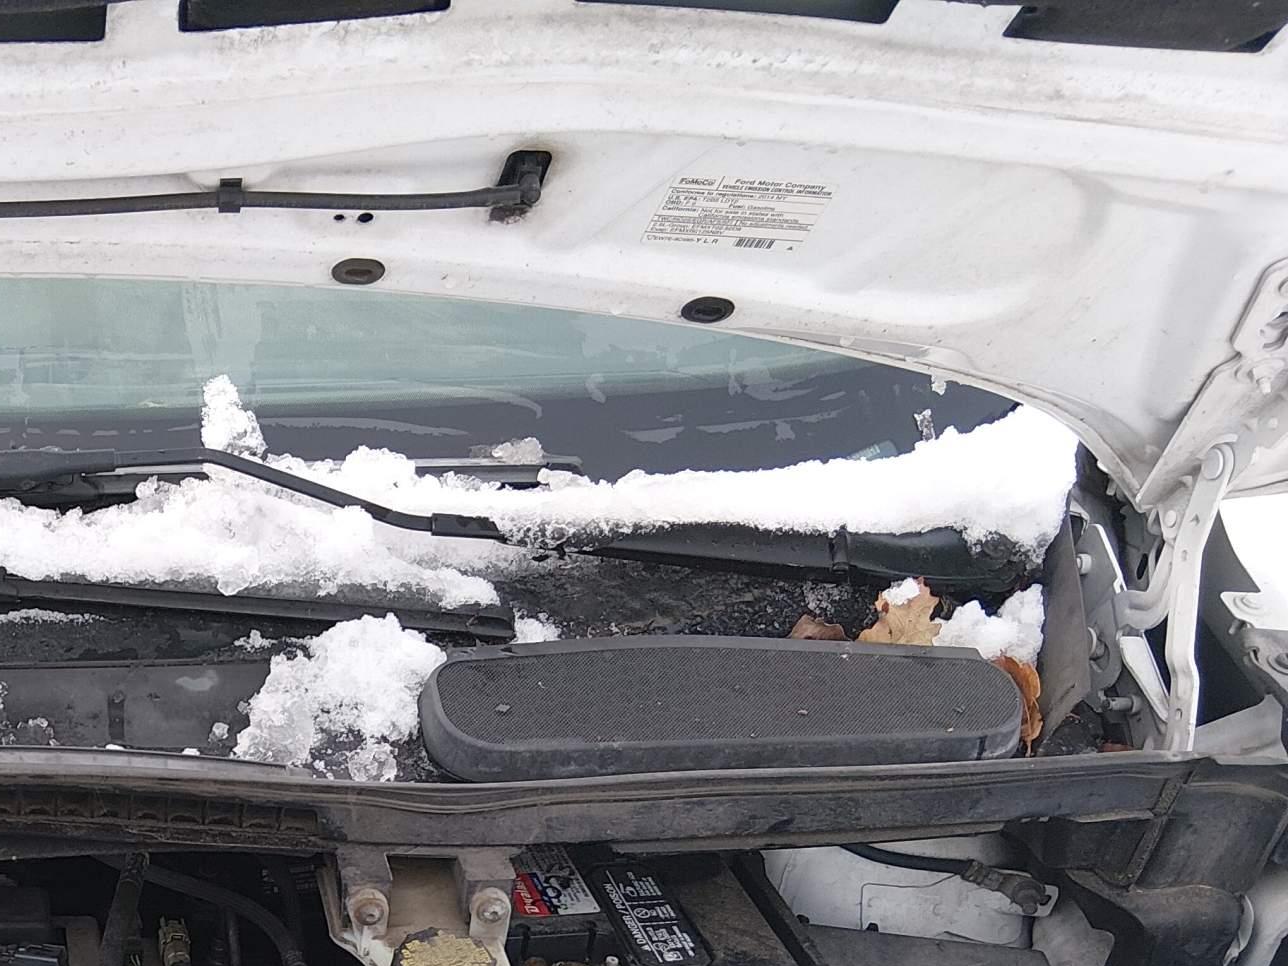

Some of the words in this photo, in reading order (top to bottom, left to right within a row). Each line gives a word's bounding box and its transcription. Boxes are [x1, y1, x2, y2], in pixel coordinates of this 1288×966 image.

[678, 177, 717, 187] FoMoCo
[734, 178, 755, 186] Ford
[757, 180, 784, 188] Motor
[785, 181, 827, 192] Company
[603, 883, 626, 909] POISON
[622, 915, 647, 945] DANGER
